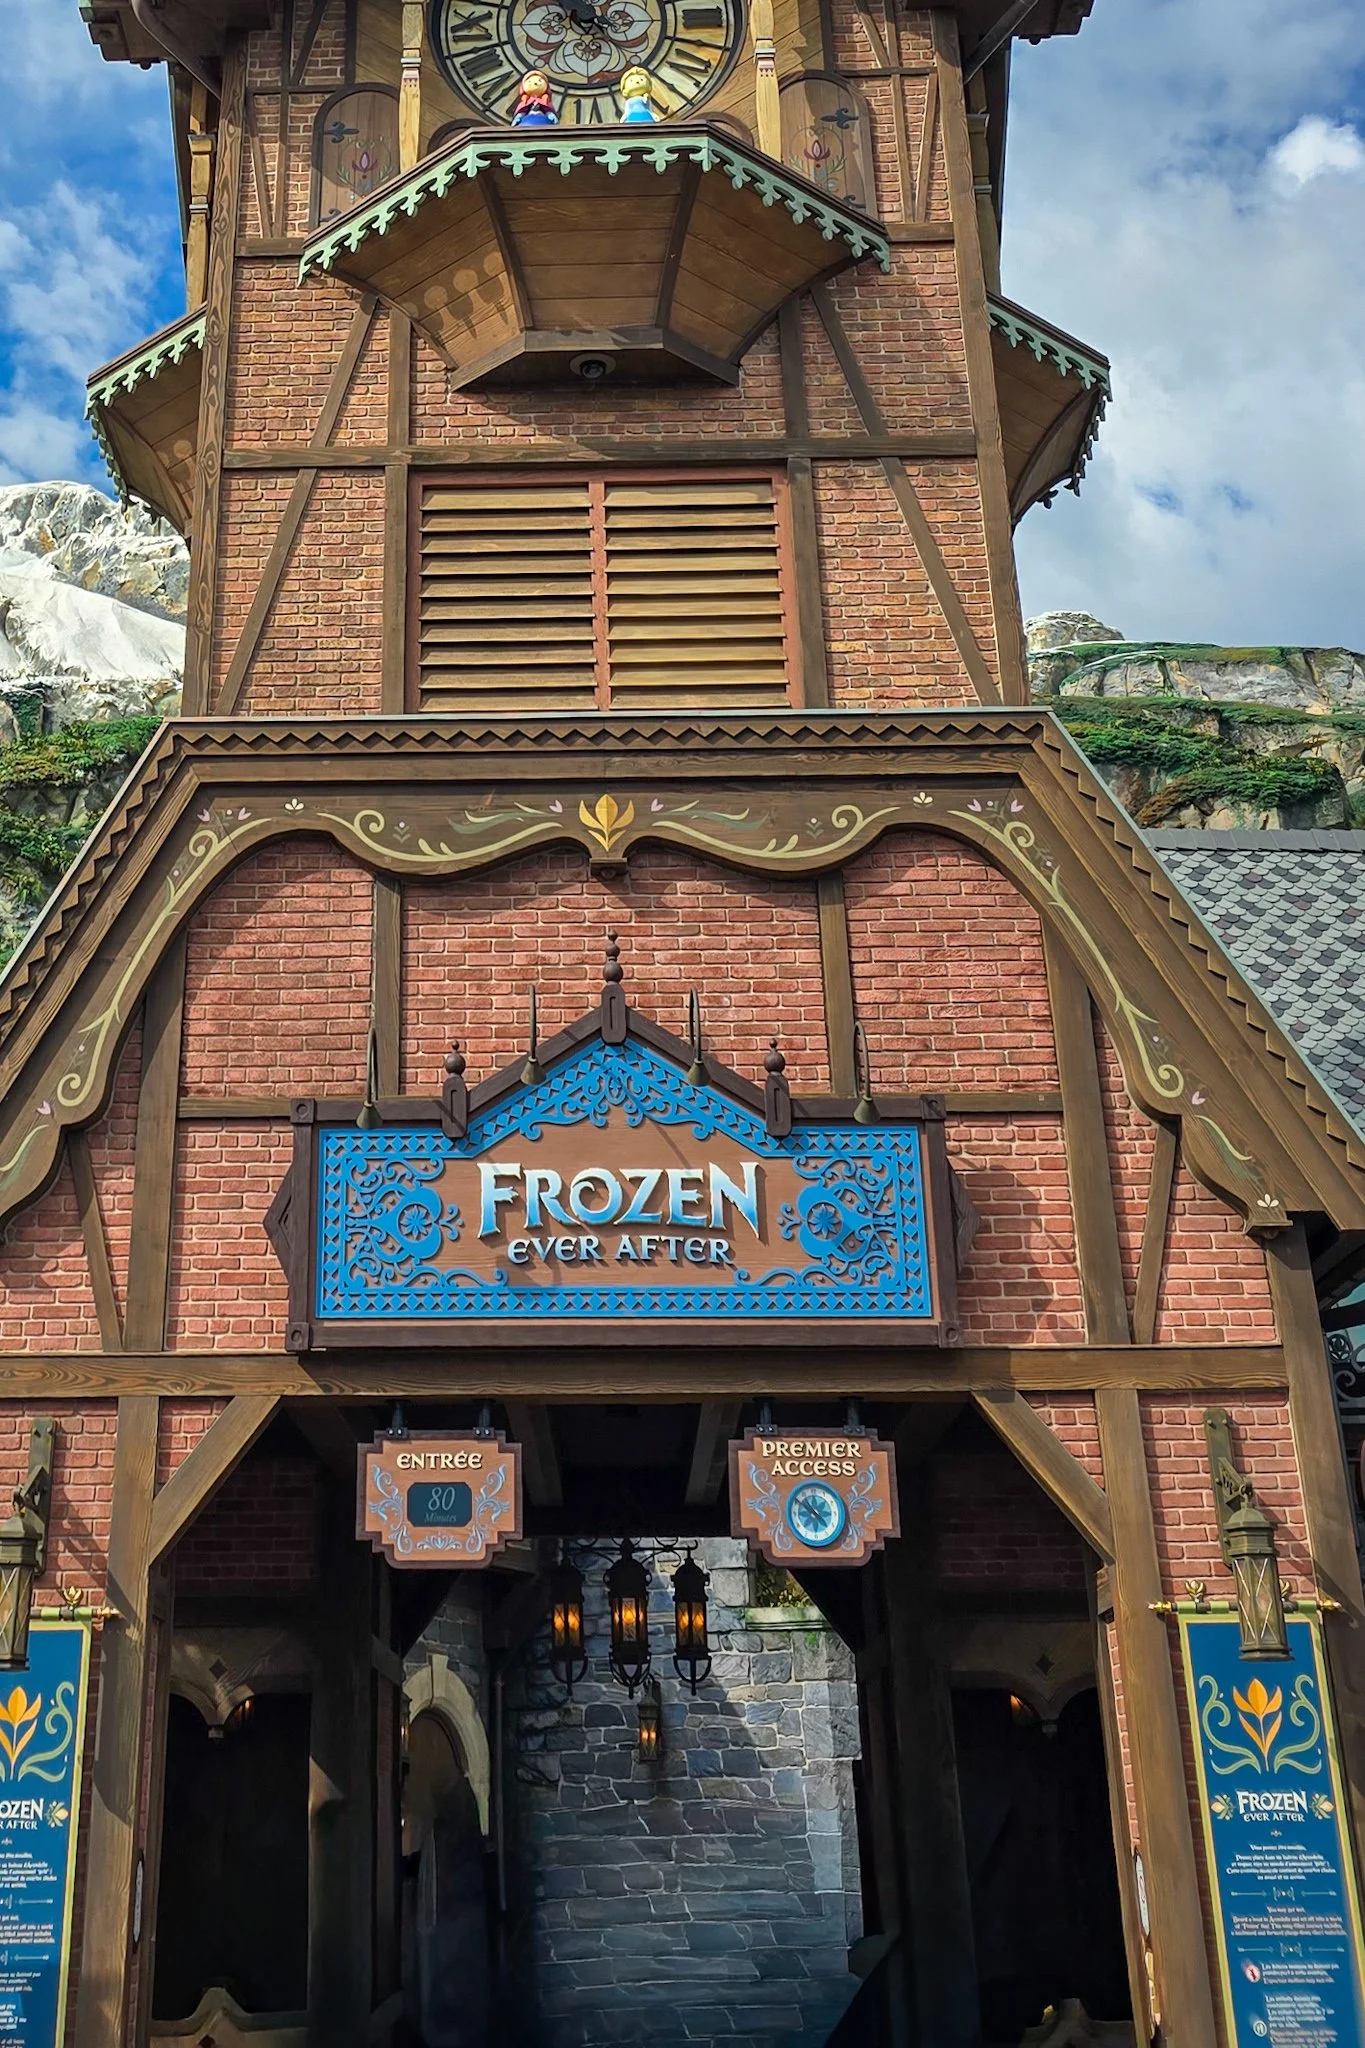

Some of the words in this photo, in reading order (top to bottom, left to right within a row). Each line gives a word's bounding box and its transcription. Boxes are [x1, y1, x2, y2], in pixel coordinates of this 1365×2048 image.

[476, 1161, 760, 1239] FROZEN
[507, 1236, 602, 1265] EVER
[614, 1235, 733, 1265] AFTER
[761, 1440, 862, 1458] PREMIER
[396, 1450, 483, 1469] ENTRÉE
[771, 1460, 856, 1476] ACCESS
[428, 1486, 456, 1511] 80
[424, 1512, 457, 1523] Minutes
[0, 1798, 44, 1820] OZEN
[1236, 1789, 1308, 1814] FROZEN
[6, 1820, 38, 1830] AFTER
[1243, 1813, 1270, 1822] EVER
[1272, 1812, 1306, 1822] AFTER
